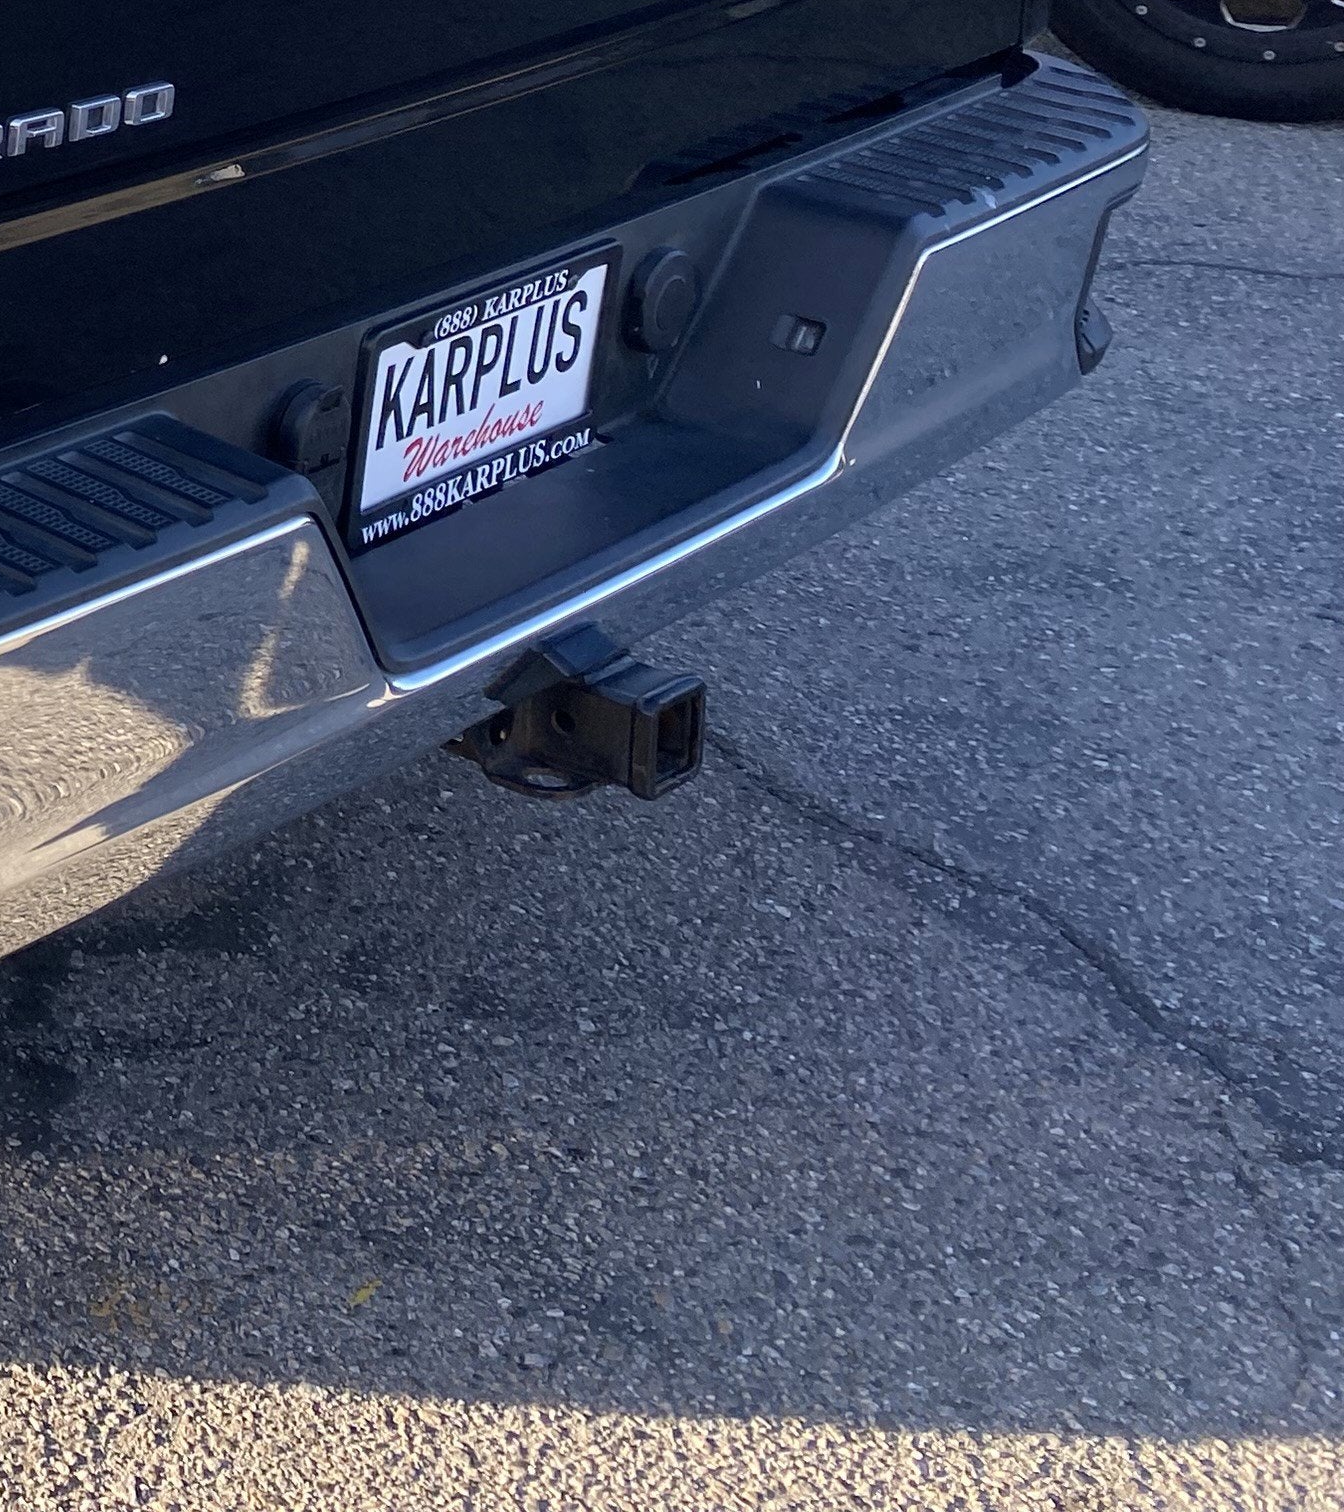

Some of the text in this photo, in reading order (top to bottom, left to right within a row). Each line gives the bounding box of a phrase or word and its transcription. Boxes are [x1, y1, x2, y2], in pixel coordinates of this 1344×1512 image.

[434, 269, 569, 340] (888) KARPLUS
[375, 289, 588, 452] KARPLUS
[402, 399, 545, 484] Warehouse
